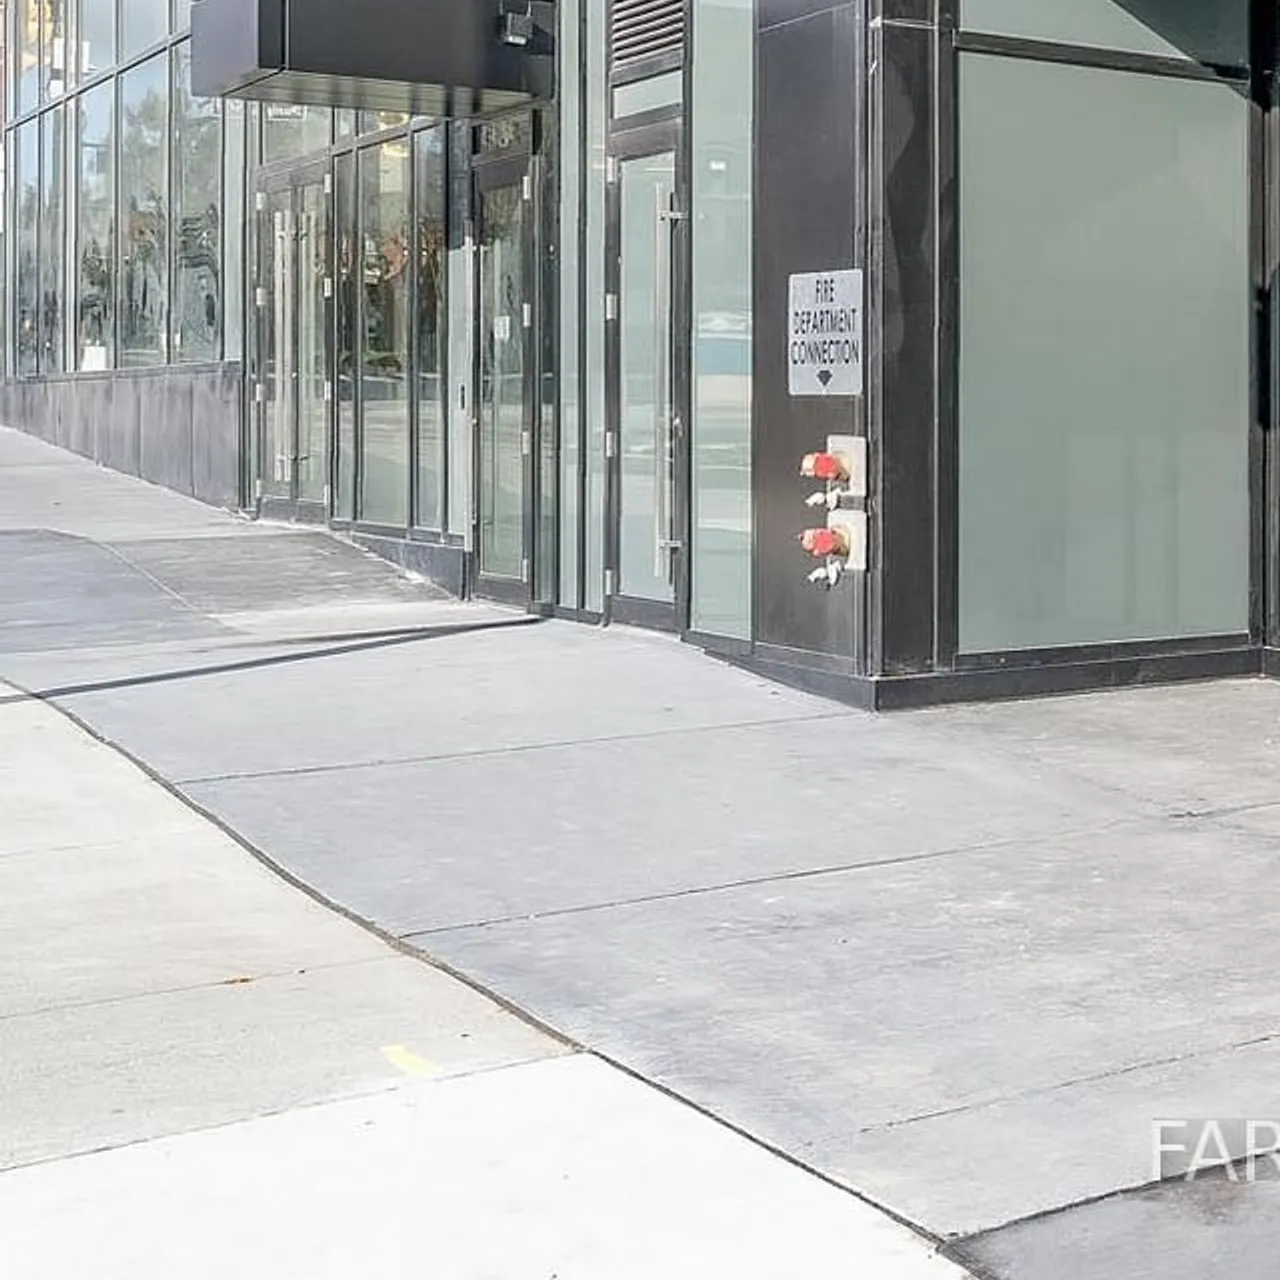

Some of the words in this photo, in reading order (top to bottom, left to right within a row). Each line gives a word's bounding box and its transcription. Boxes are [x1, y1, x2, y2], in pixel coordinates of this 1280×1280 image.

[815, 278, 835, 303] FIRE
[793, 307, 857, 335] DEPARTMENT
[791, 339, 860, 365] CONNECTION
